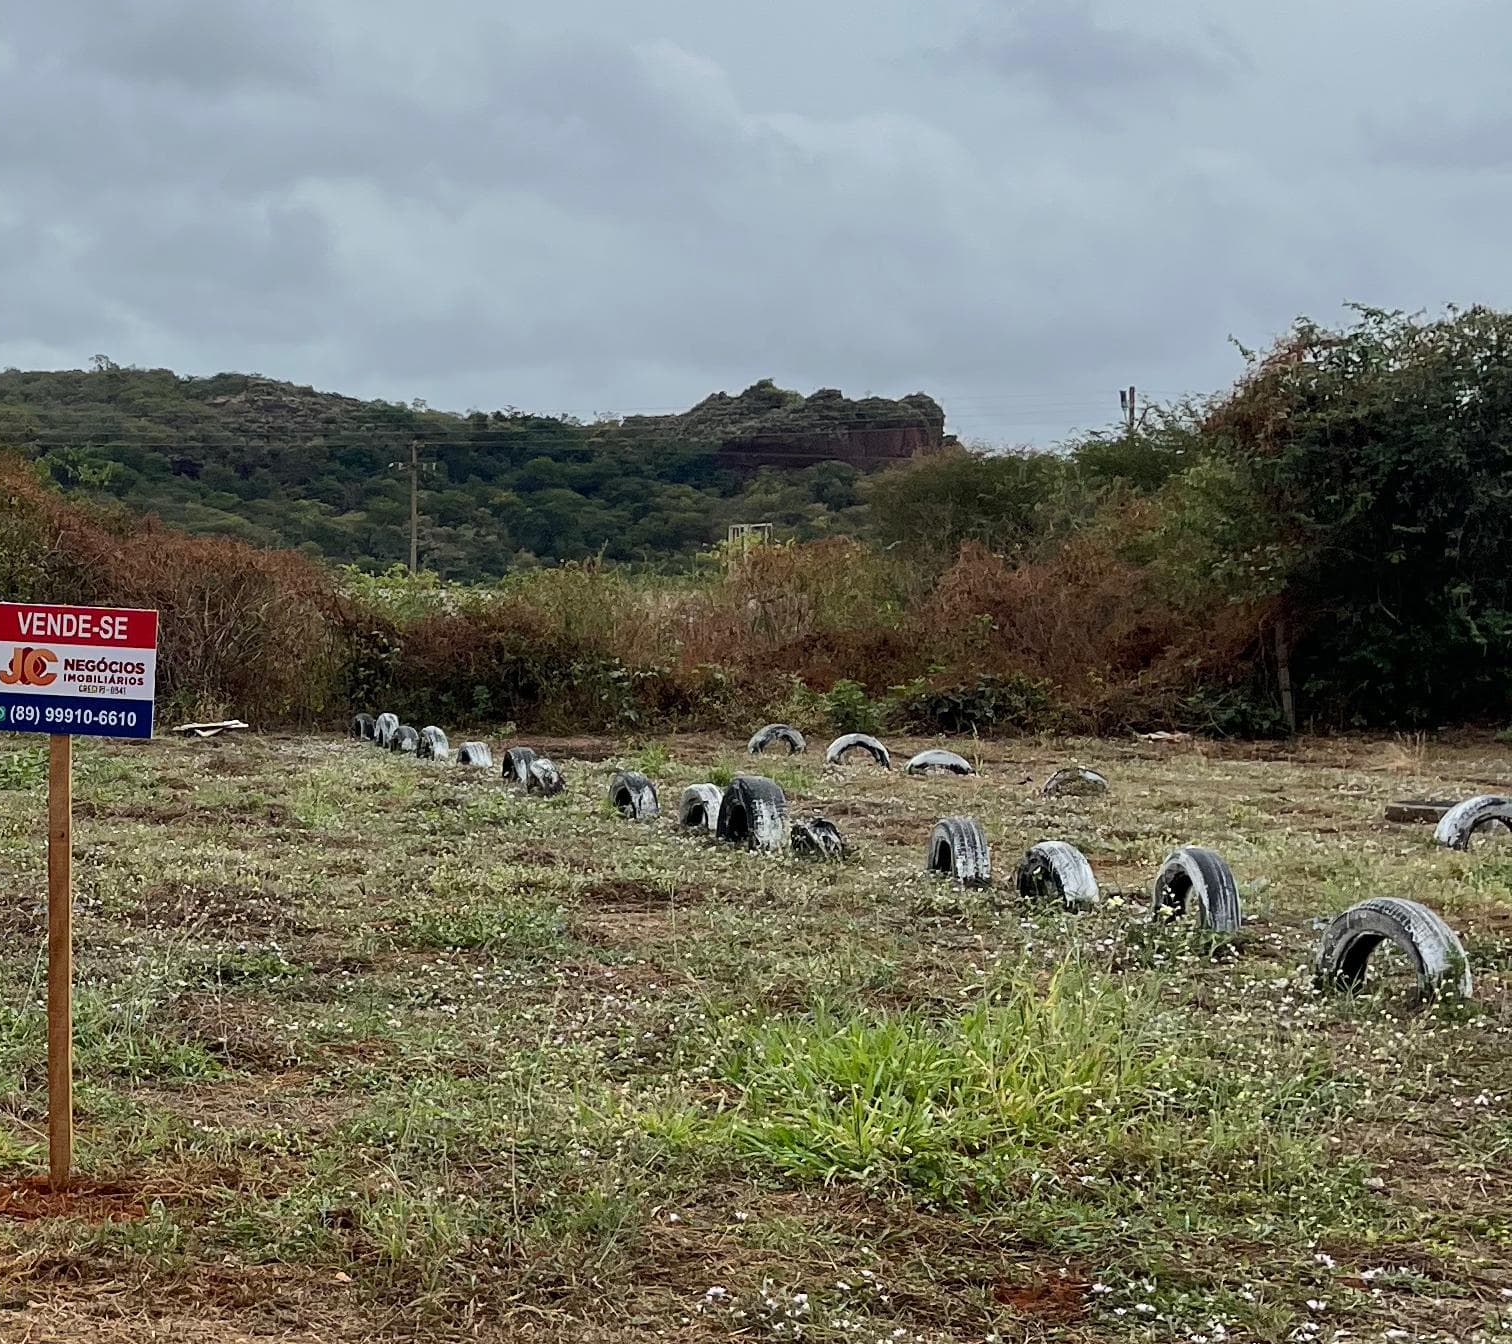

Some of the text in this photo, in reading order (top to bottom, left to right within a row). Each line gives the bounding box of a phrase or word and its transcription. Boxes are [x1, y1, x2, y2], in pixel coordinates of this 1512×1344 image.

[17, 611, 129, 640] VENDE-SE
[63, 657, 145, 674] NEGÓCIOS
[63, 673, 144, 685] IMOBILIÁRIOS
[10, 704, 137, 727] (89) 99910-6610
